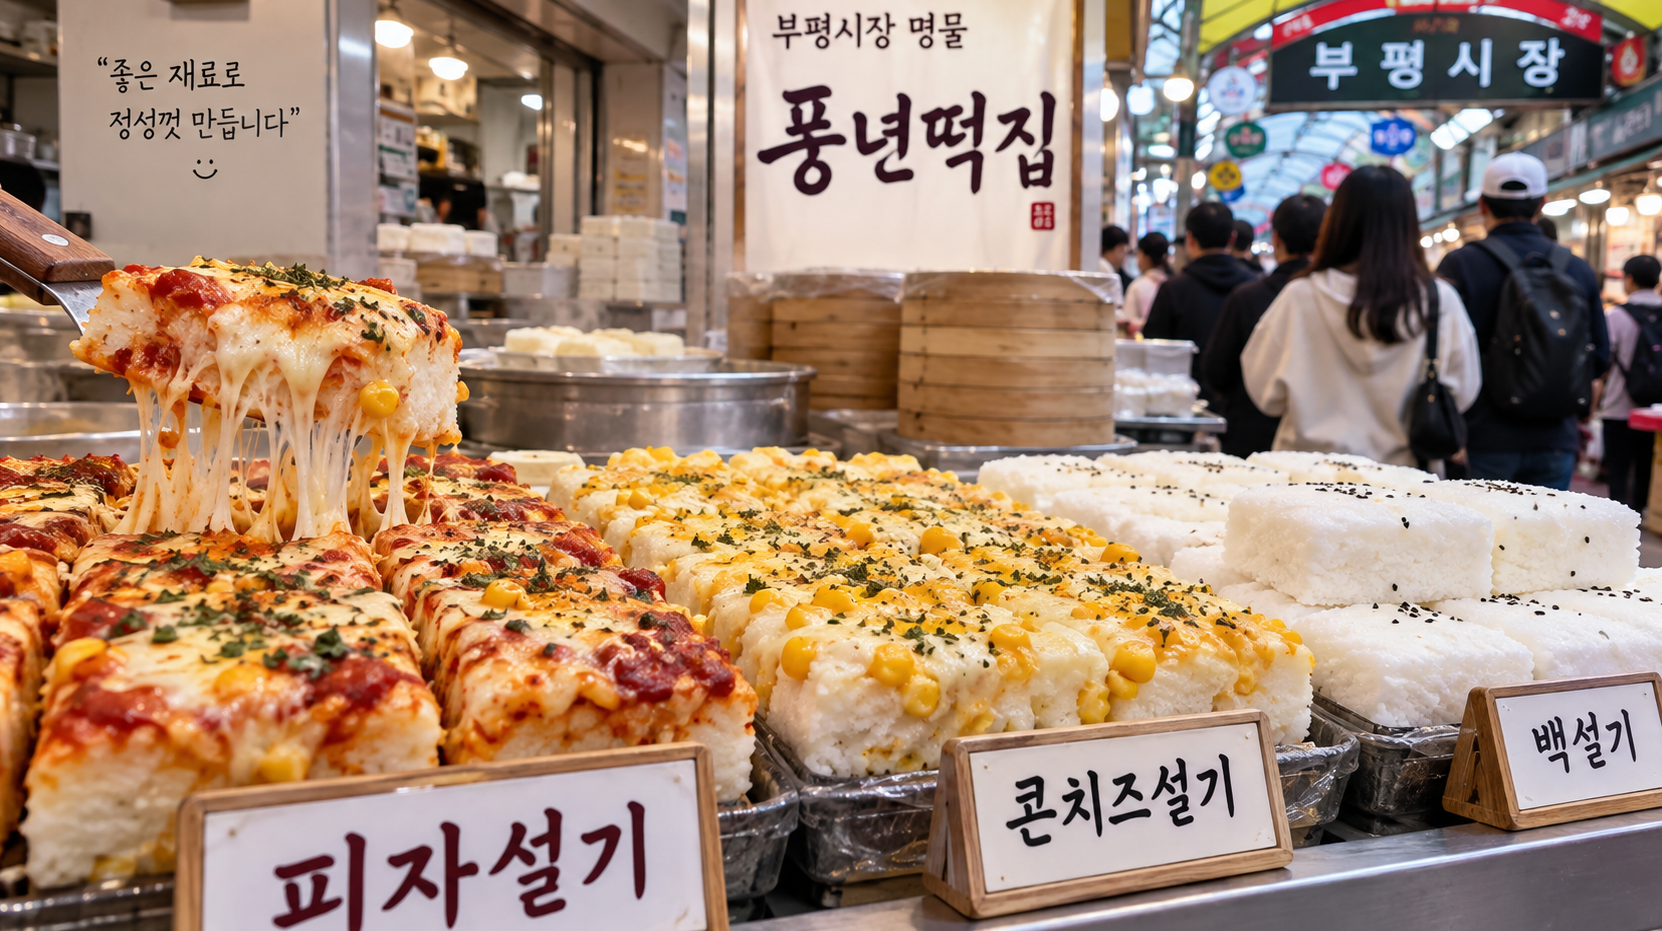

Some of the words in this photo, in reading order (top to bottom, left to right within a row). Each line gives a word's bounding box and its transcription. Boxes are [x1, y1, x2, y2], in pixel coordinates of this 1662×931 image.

[772, 12, 896, 50] 부평시장
[909, 12, 969, 49] 명물
[97, 56, 158, 94] “좋은
[168, 58, 245, 92] 재료로
[109, 107, 181, 140] 정성껏
[191, 106, 300, 141] 만듭니다”
[756, 84, 1057, 196] 풍년떡집
[1531, 708, 1638, 774] 백설기
[1005, 753, 1235, 847] 콘치즈설기
[273, 800, 646, 931] 피자설기
